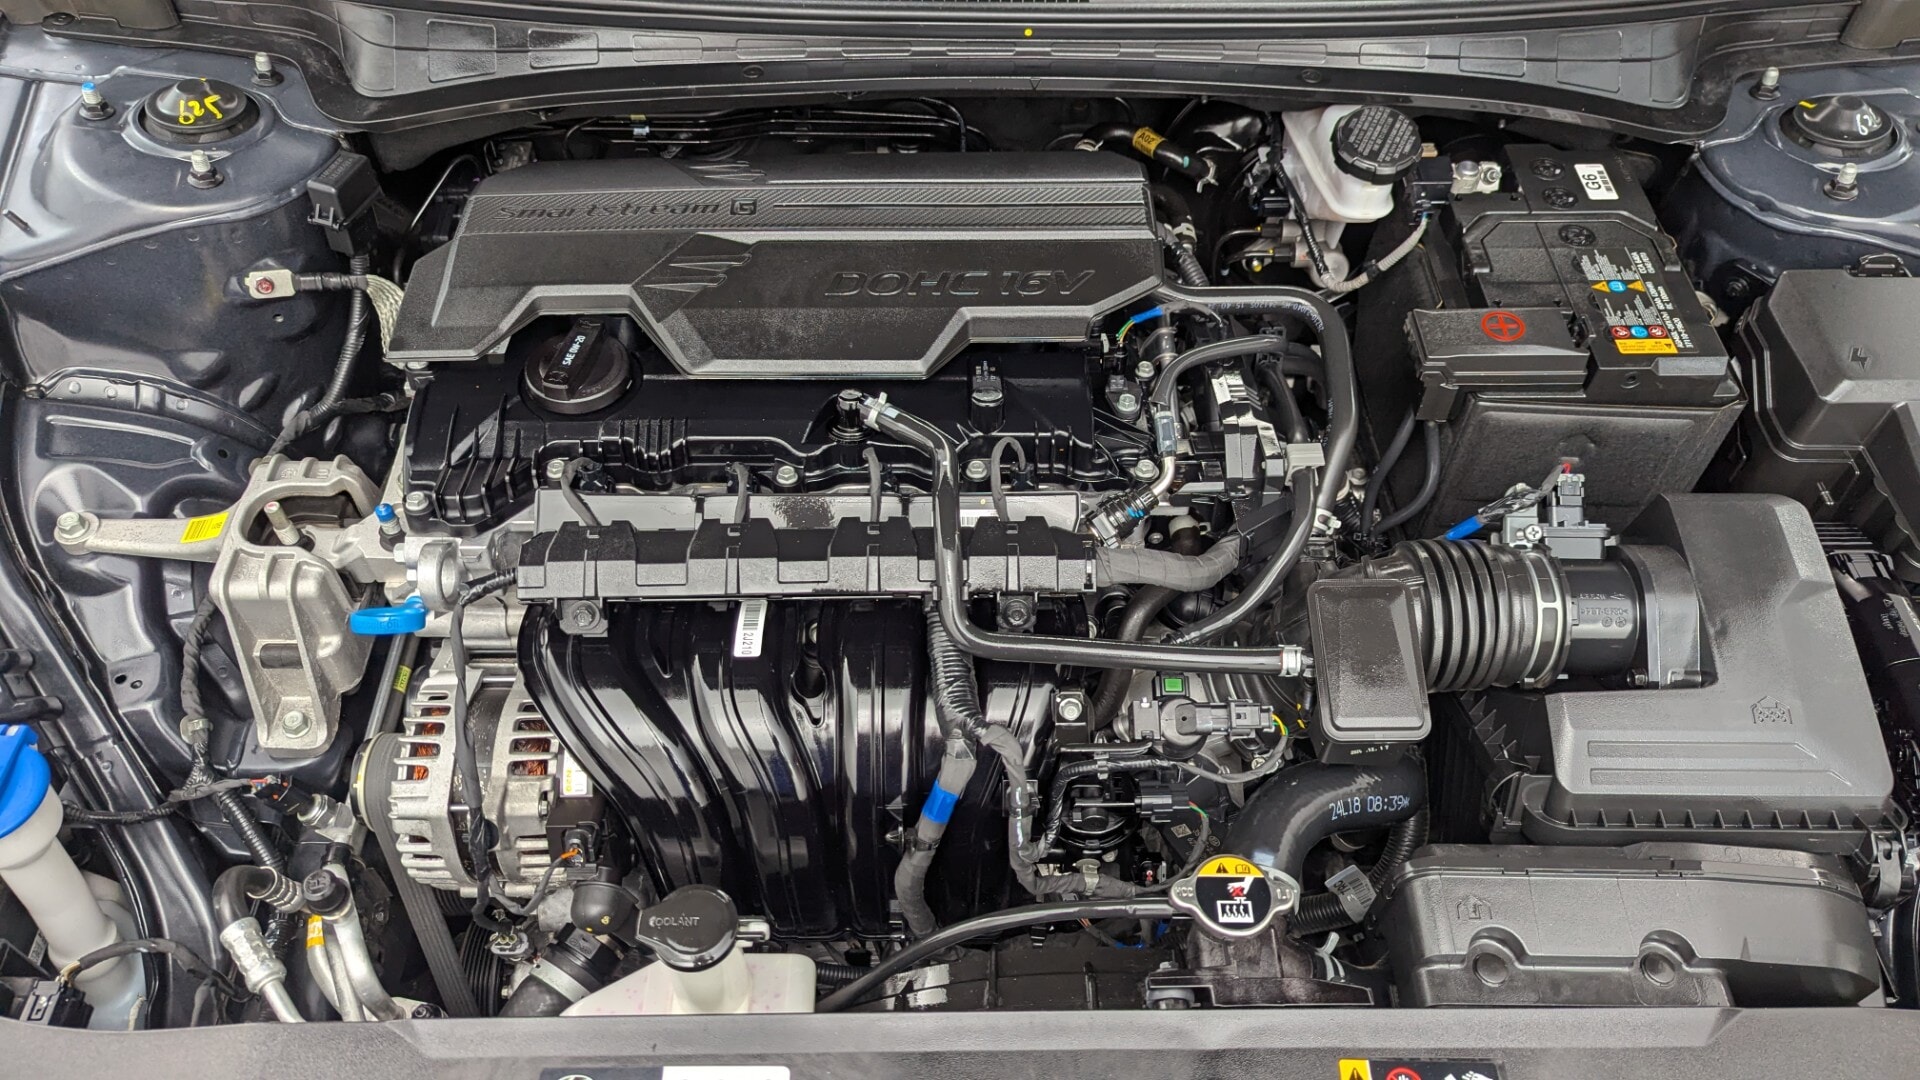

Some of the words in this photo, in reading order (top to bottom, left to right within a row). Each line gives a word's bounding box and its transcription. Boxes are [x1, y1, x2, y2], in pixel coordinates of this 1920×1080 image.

[1582, 173, 1602, 190] G6
[493, 203, 720, 220] Smartstream
[825, 271, 988, 296] DOHC
[1001, 270, 1095, 296] 16V
[562, 353, 575, 366] SAE
[569, 335, 586, 354] 0W-20
[741, 632, 754, 655] 2J210
[1329, 796, 1361, 820] 24L18
[648, 915, 700, 928] COOLANT
